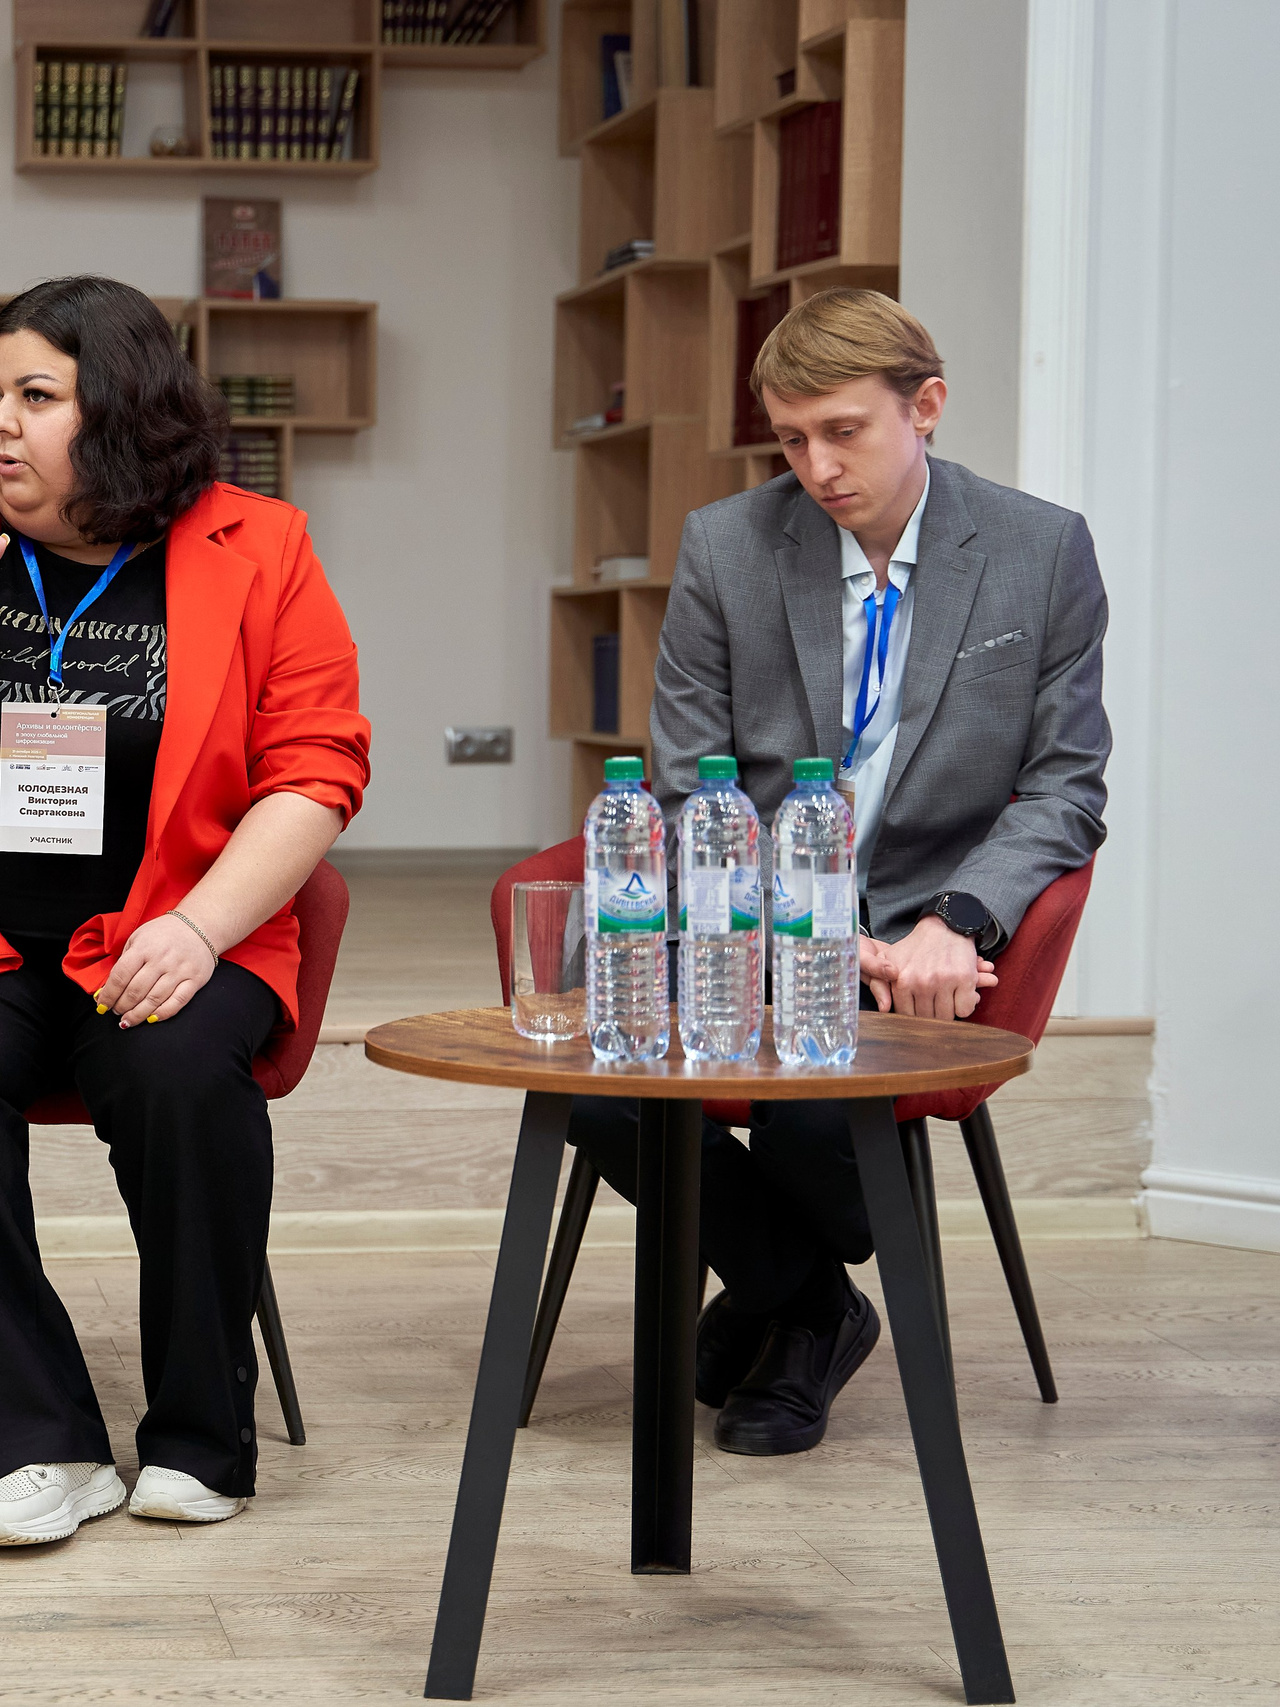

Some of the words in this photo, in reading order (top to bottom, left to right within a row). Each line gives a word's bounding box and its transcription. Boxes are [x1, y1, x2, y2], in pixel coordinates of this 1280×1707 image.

[16, 722, 44, 731] Архивы
[52, 724, 102, 732] волонтёрство
[18, 784, 89, 794] КОЛОДЕЗНАЯ
[28, 796, 78, 806] Виктория
[19, 807, 86, 817] Спартаковна
[30, 836, 73, 844] УЧАСТНИК
